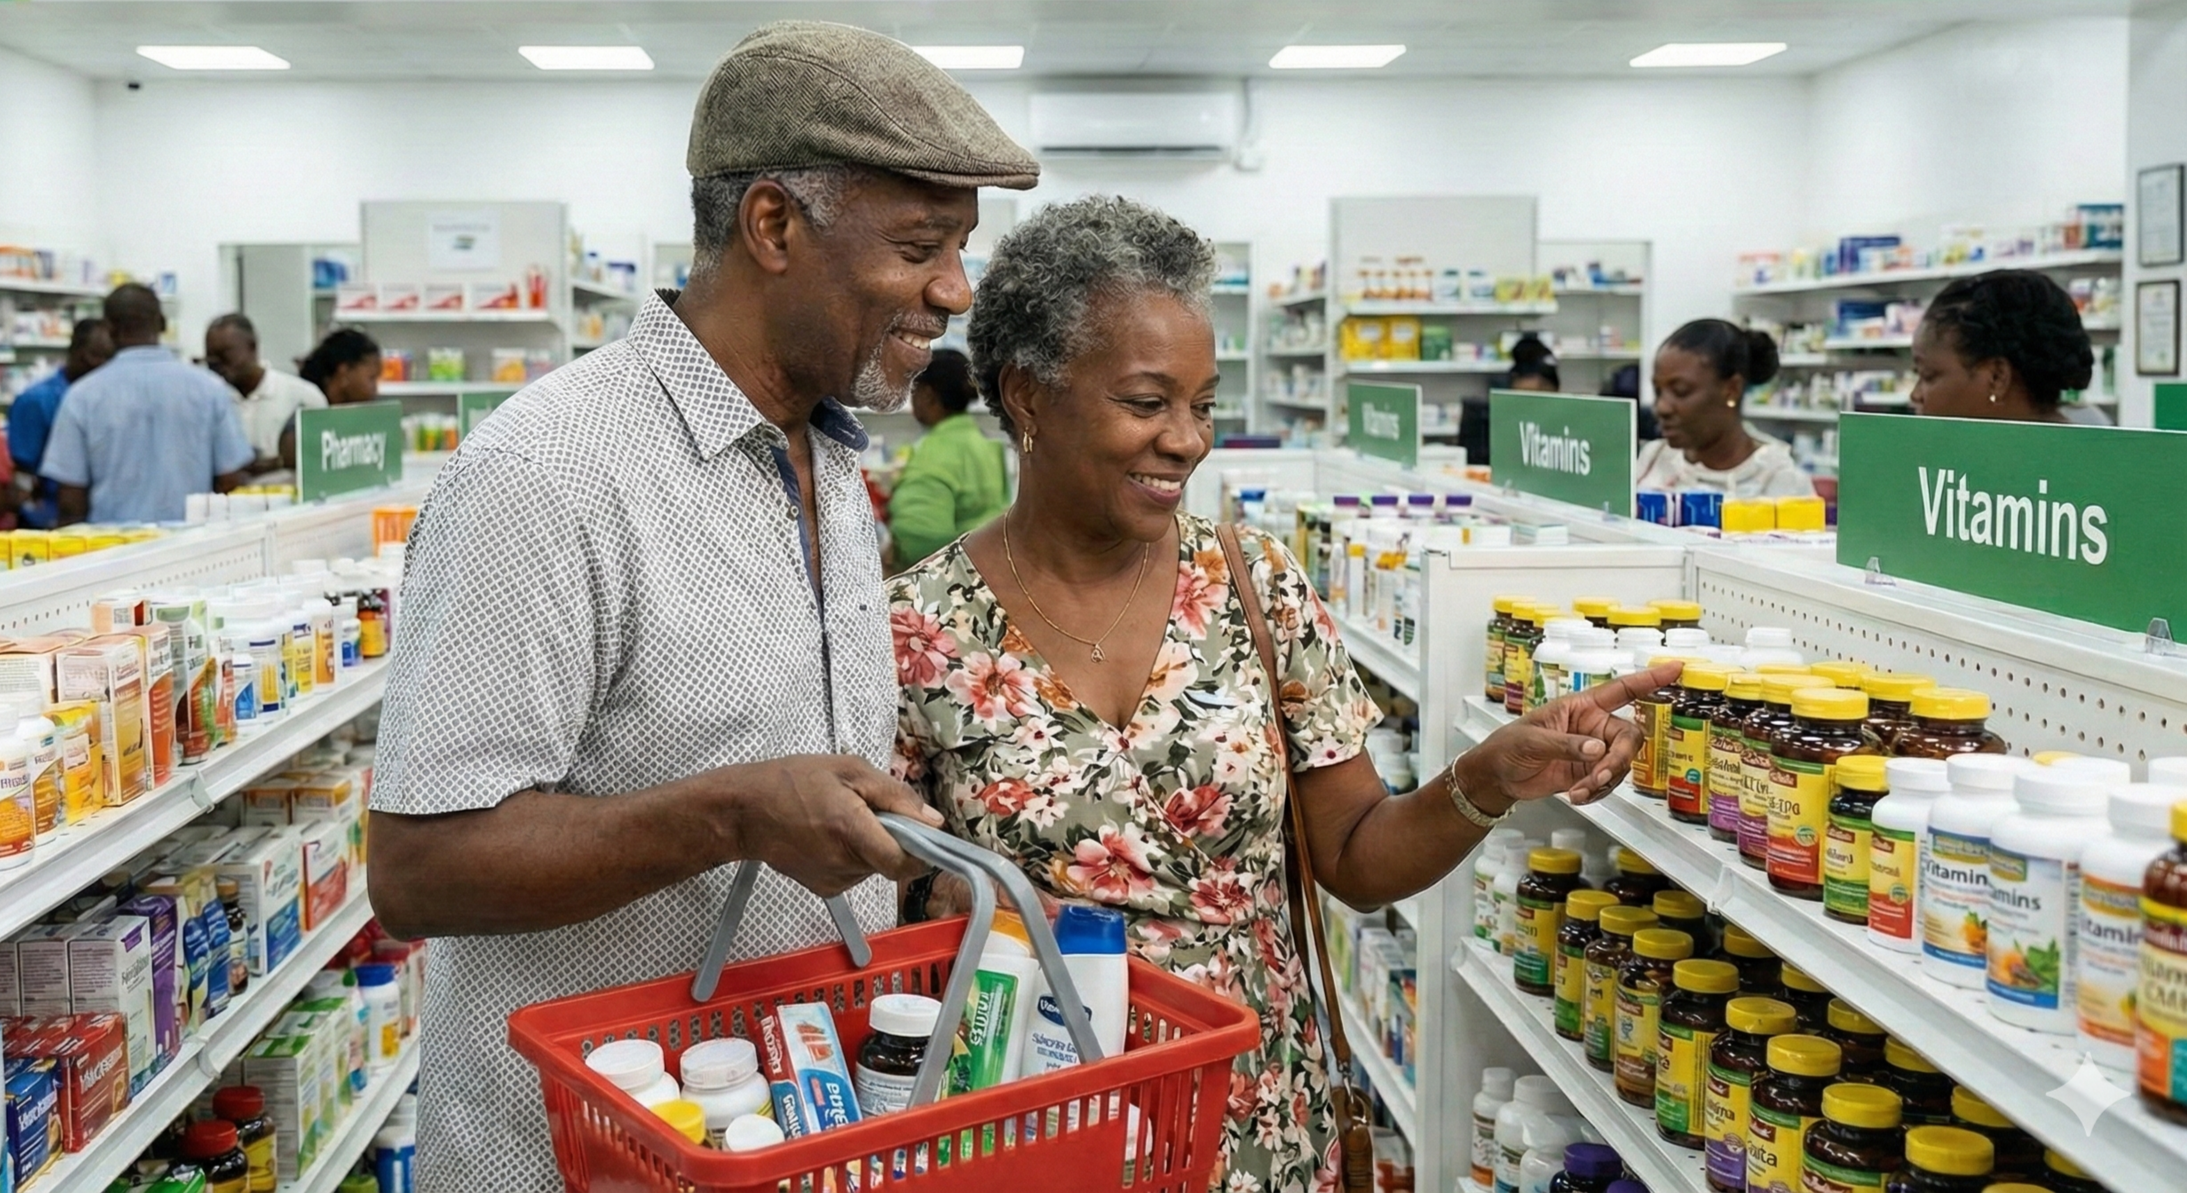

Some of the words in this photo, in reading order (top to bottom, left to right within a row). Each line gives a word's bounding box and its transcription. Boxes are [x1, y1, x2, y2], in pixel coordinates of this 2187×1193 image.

[321, 429, 387, 472] Pharmacy
[1519, 421, 1591, 476] Vitamins
[1918, 466, 2108, 565] Vitamins
